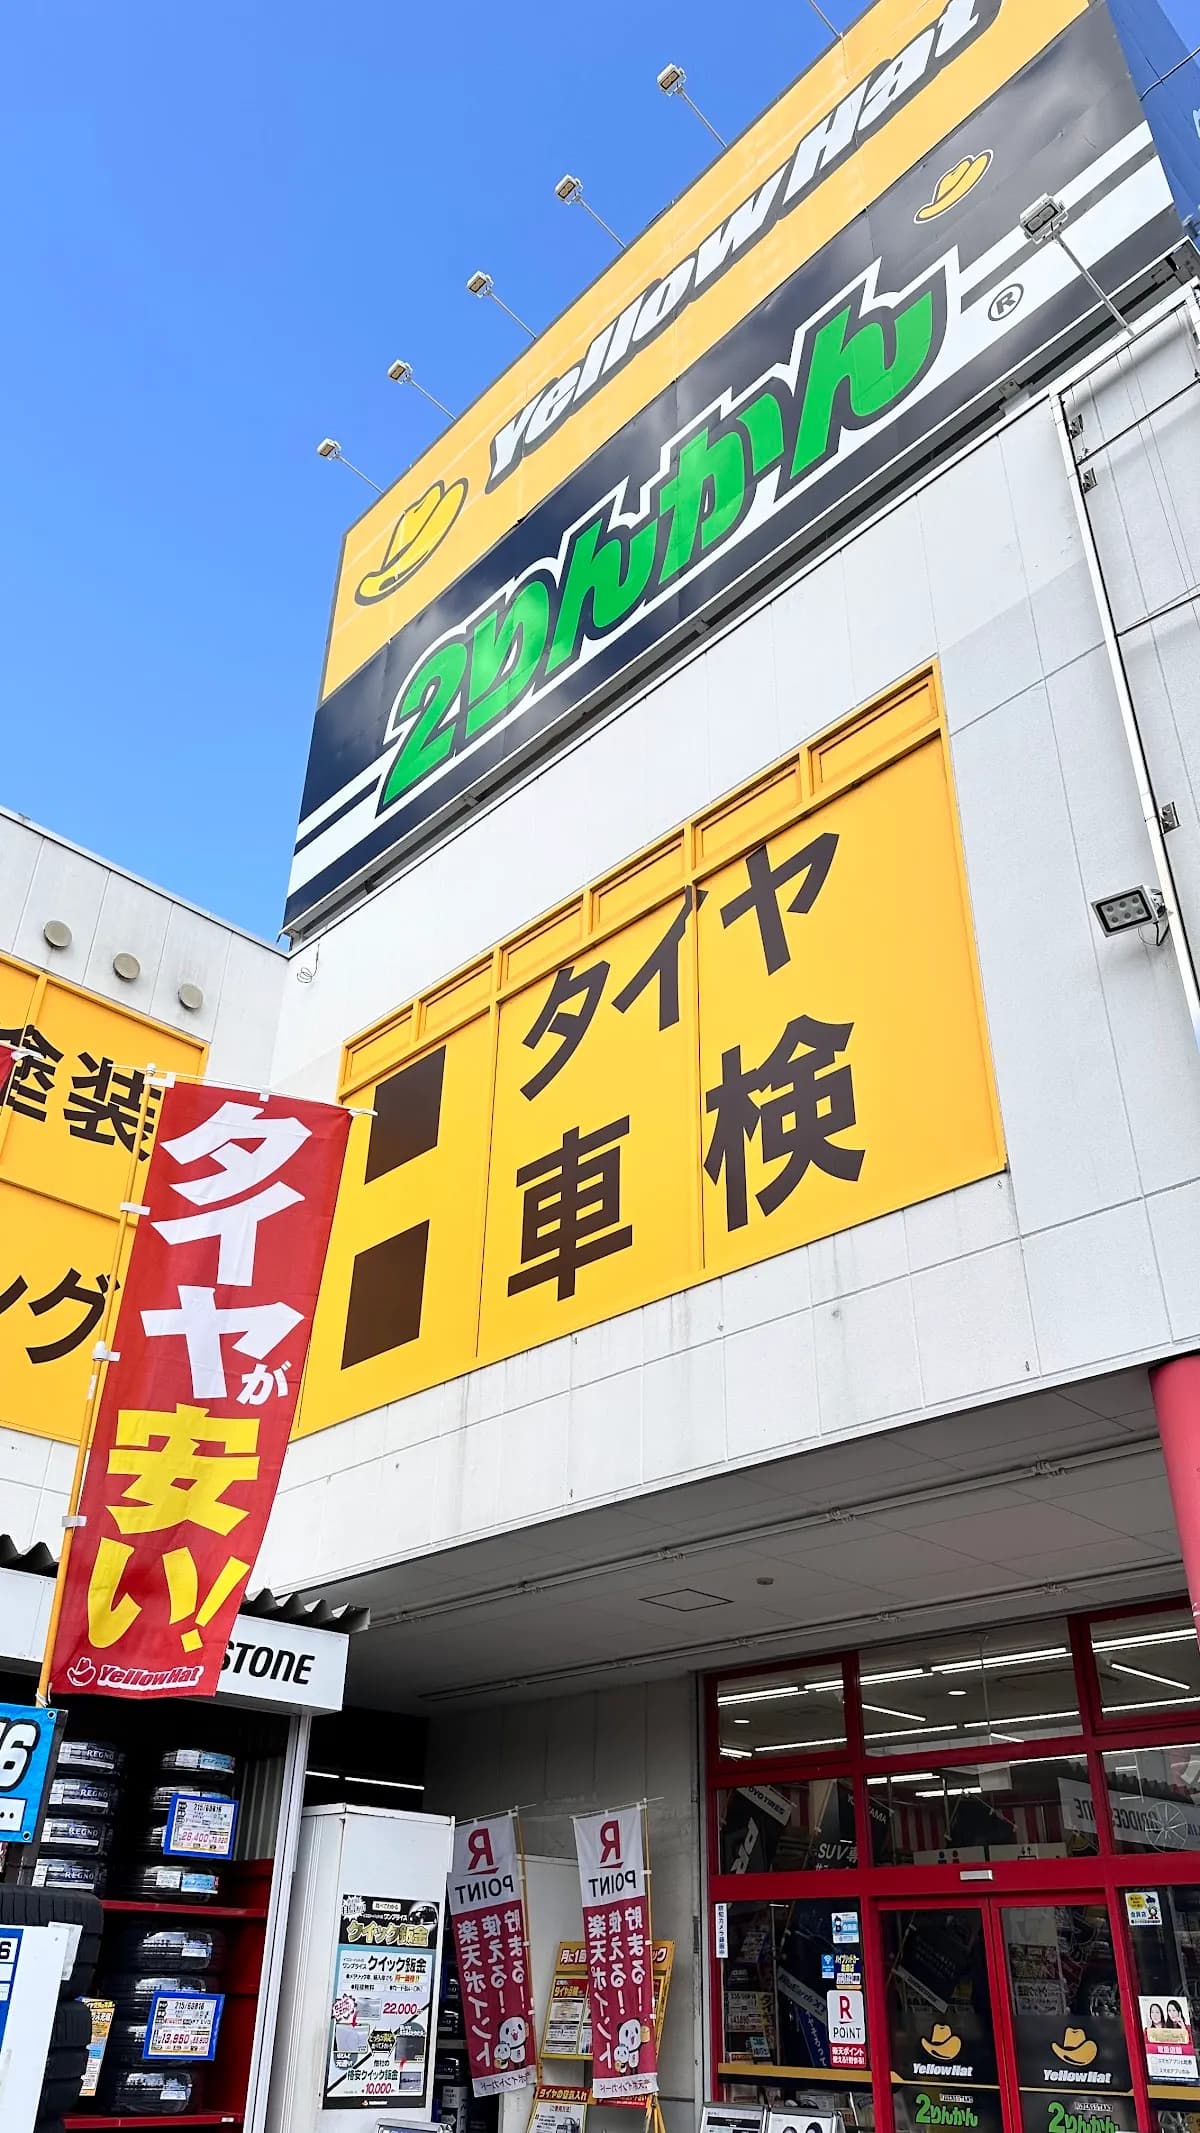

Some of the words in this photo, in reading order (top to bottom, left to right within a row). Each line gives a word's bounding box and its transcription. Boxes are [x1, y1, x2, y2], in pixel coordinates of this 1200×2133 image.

[380, 284, 936, 808] 2りんかん
[520, 832, 840, 1101] タイヤ
[508, 1014, 866, 1302] 車検
[98, 1664, 203, 1691] YellowHat
[86, 1750, 114, 1760] REGNO
[79, 1788, 109, 1799] REGNO
[68, 1827, 98, 1837] REGNO
[64, 1870, 94, 1881] REGNO
[346, 1920, 429, 1947] クイック鈑金
[367, 1955, 427, 1974] クイック鈑金
[833, 2026, 861, 2039] POINT
[913, 2062, 973, 2077] YellowHat
[1043, 2069, 1112, 2084] YellowHat
[915, 2093, 979, 2128] 2りんかん
